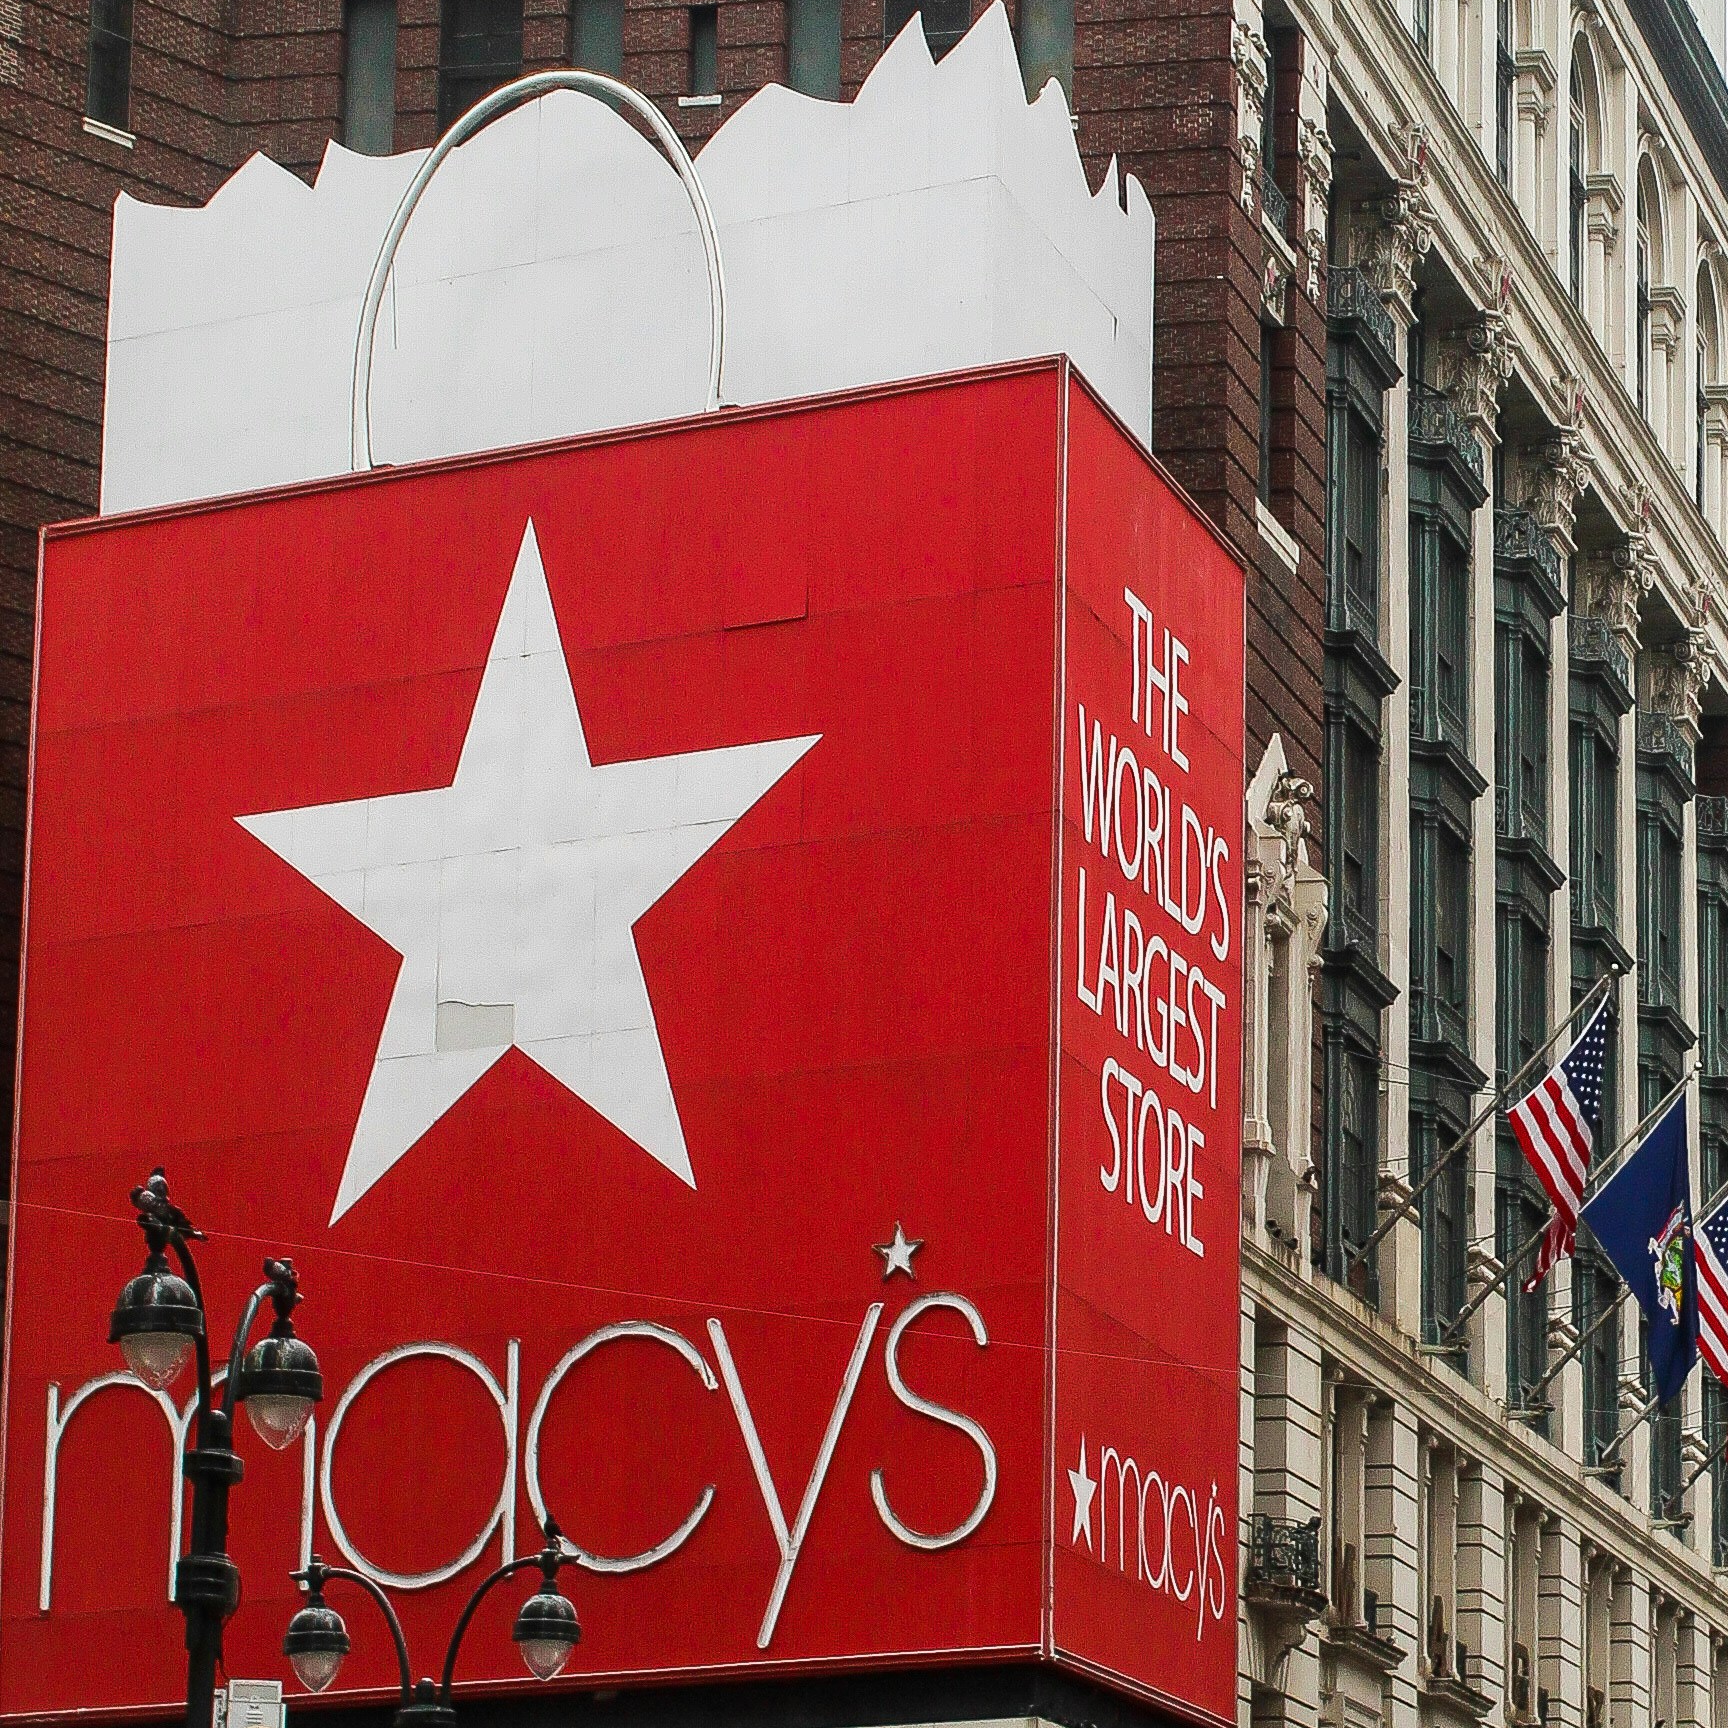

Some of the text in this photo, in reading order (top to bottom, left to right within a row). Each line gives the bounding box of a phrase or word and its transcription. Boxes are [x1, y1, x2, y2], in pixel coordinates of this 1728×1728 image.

[1124, 586, 1191, 774] THE
[1077, 702, 1230, 962] WORLD'S
[1077, 867, 1226, 1111] LARGEST
[1100, 1056, 1206, 1259] STORE
